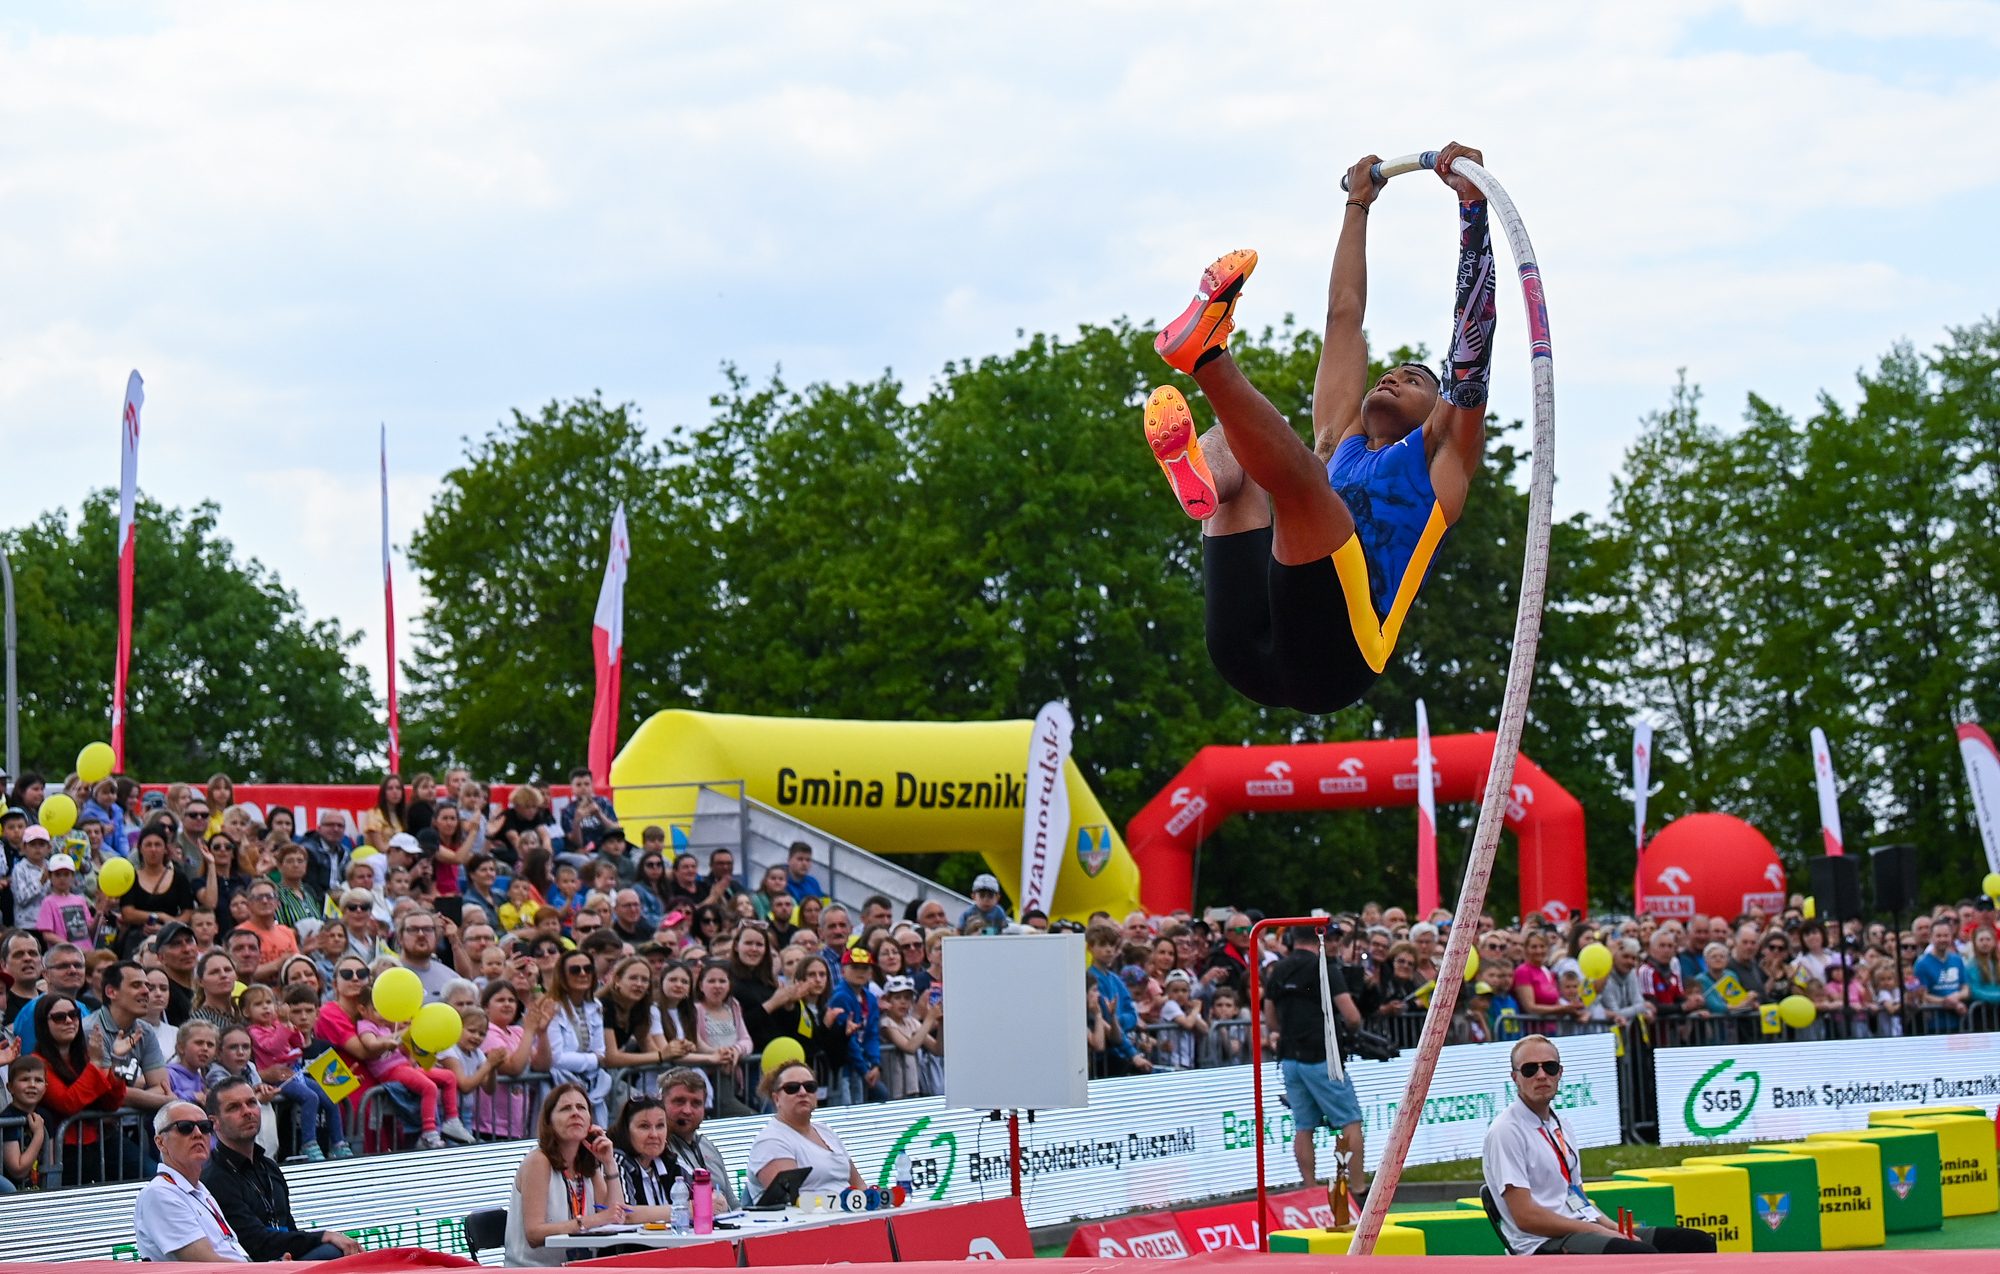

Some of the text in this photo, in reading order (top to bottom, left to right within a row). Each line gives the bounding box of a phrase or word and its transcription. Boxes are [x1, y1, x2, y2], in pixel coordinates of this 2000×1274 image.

[777, 767, 1028, 809] Gmina Duszniki
[1646, 900, 1689, 912] RLEN
[1702, 1088, 1743, 1112] SGB
[1772, 1085, 1817, 1109] Bank
[1128, 1125, 1196, 1161] Duszniki
[911, 1157, 938, 1191] GB
[1941, 1168, 1988, 1185] uszniki
[880, 1190, 890, 1206] 9
[1818, 1184, 1862, 1198] mina
[826, 1194, 837, 1209] 7
[851, 1194, 863, 1210] 8
[1820, 1197, 1872, 1214] szniki
[1134, 1234, 1182, 1258] ORLEN
